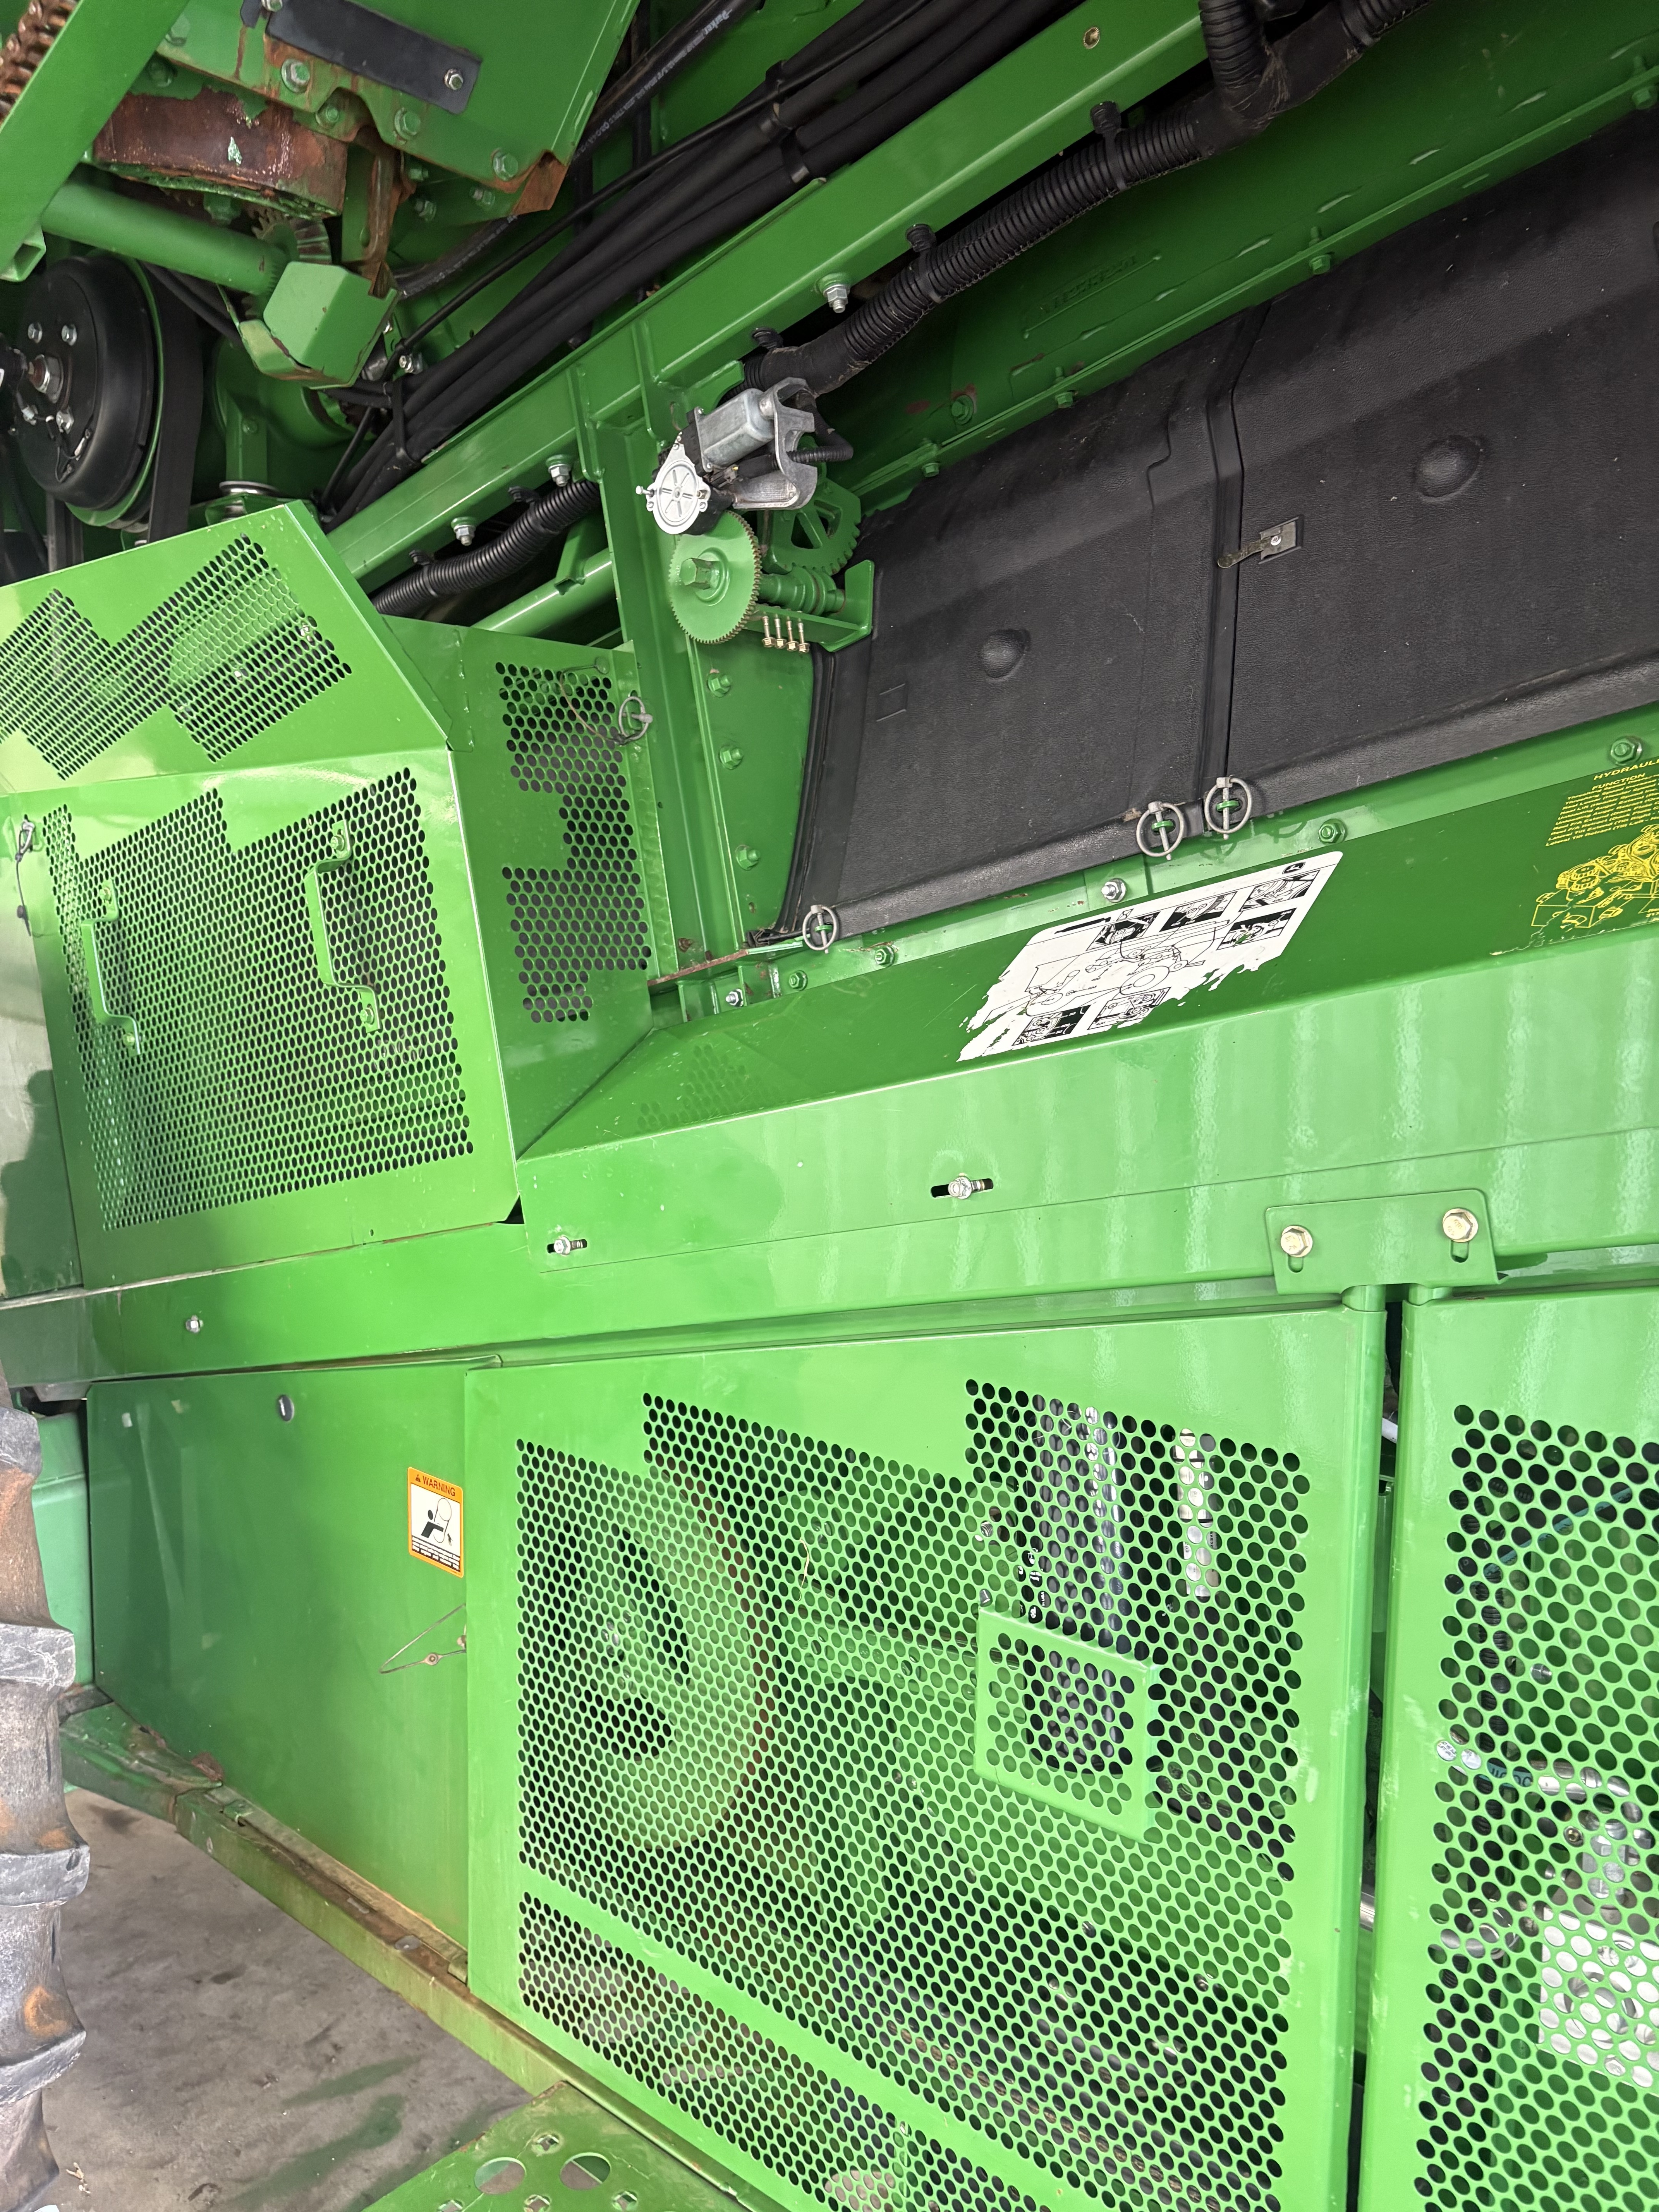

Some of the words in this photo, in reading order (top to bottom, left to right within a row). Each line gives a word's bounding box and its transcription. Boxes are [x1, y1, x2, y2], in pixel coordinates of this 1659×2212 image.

[1592, 773, 1645, 790] FUNCTION
[1546, 838, 1570, 846] Lateral
[1548, 832, 1572, 841] Lateral
[422, 1475, 455, 1496] WARNING
